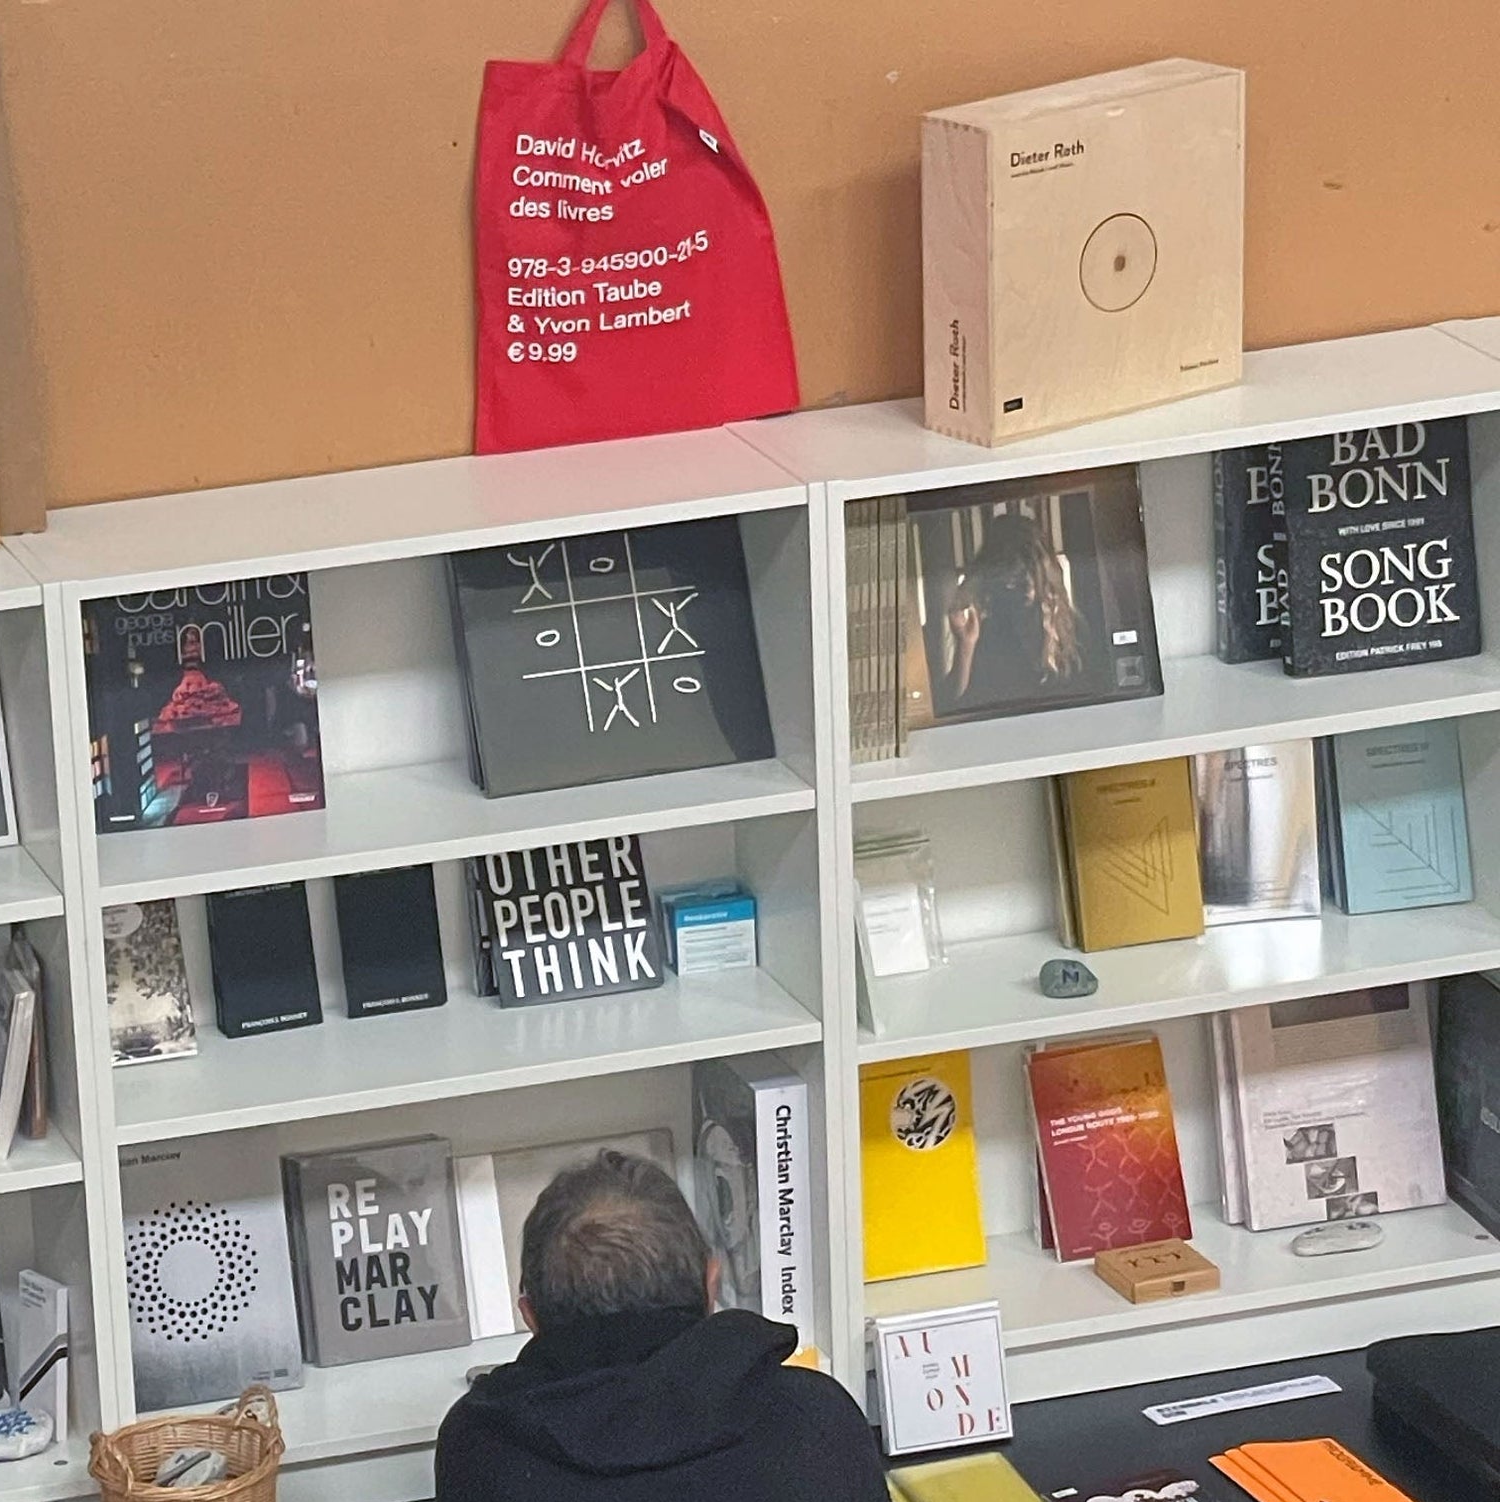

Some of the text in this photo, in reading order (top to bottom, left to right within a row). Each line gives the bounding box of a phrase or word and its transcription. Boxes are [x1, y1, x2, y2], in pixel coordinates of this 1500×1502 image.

[516, 134, 576, 159] David
[1010, 138, 1084, 168] Dieter Roth
[512, 157, 668, 195] Comment voler
[510, 197, 614, 223] des livres
[507, 300, 691, 334] & Yvon Lambert
[508, 279, 662, 307] Edition Taube
[949, 319, 960, 411] Dieter Roth
[1330, 422, 1426, 467] BAD
[1306, 458, 1450, 513] BONN
[1320, 535, 1452, 593] SONG
[1319, 583, 1460, 637] BOOK
[176, 605, 298, 666] miller
[1224, 756, 1277, 771] SPECTRES
[485, 834, 638, 895] OTHER
[493, 880, 647, 948] PEOPLE
[502, 931, 656, 998] THINK
[327, 1178, 380, 1221] RE
[775, 1104, 797, 1315] Christian Marclay Index
[331, 1208, 433, 1258] PLAY
[335, 1252, 411, 1295] MAR
[341, 1284, 440, 1333] CLAY
